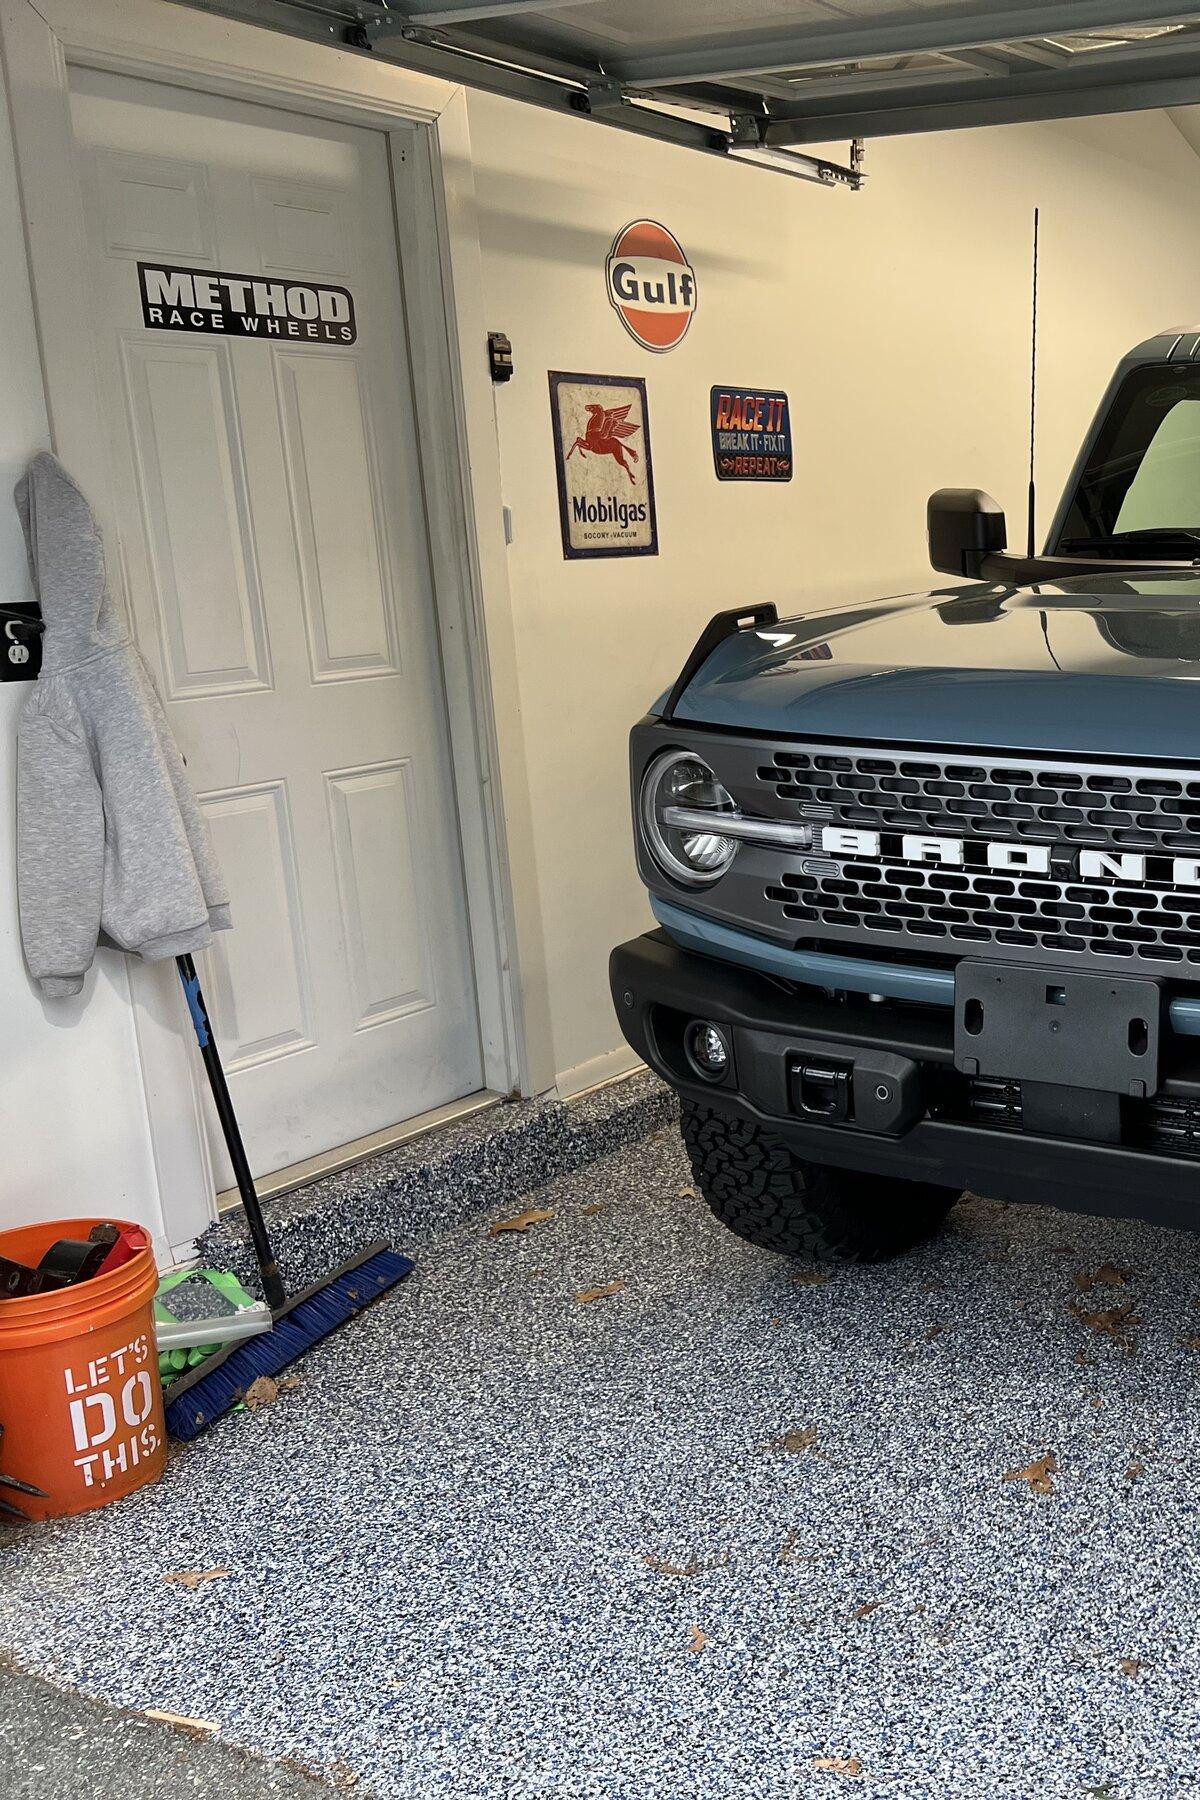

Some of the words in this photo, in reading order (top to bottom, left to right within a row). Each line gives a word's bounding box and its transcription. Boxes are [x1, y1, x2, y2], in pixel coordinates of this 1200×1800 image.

[143, 269, 351, 323] METHOD
[612, 262, 694, 306] Gulf
[148, 307, 225, 329] RACE
[241, 317, 353, 341] WHEELS
[716, 394, 766, 432] RACE
[766, 398, 786, 432] IT
[719, 432, 750, 451] BREAK
[750, 433, 760, 451] IT
[763, 434, 778, 452] FIX
[778, 435, 786, 452] IT
[735, 456, 778, 475] REPEAT
[573, 496, 647, 529] Mobilgas
[64, 1334, 148, 1395] LET'S
[69, 1370, 153, 1452] DO
